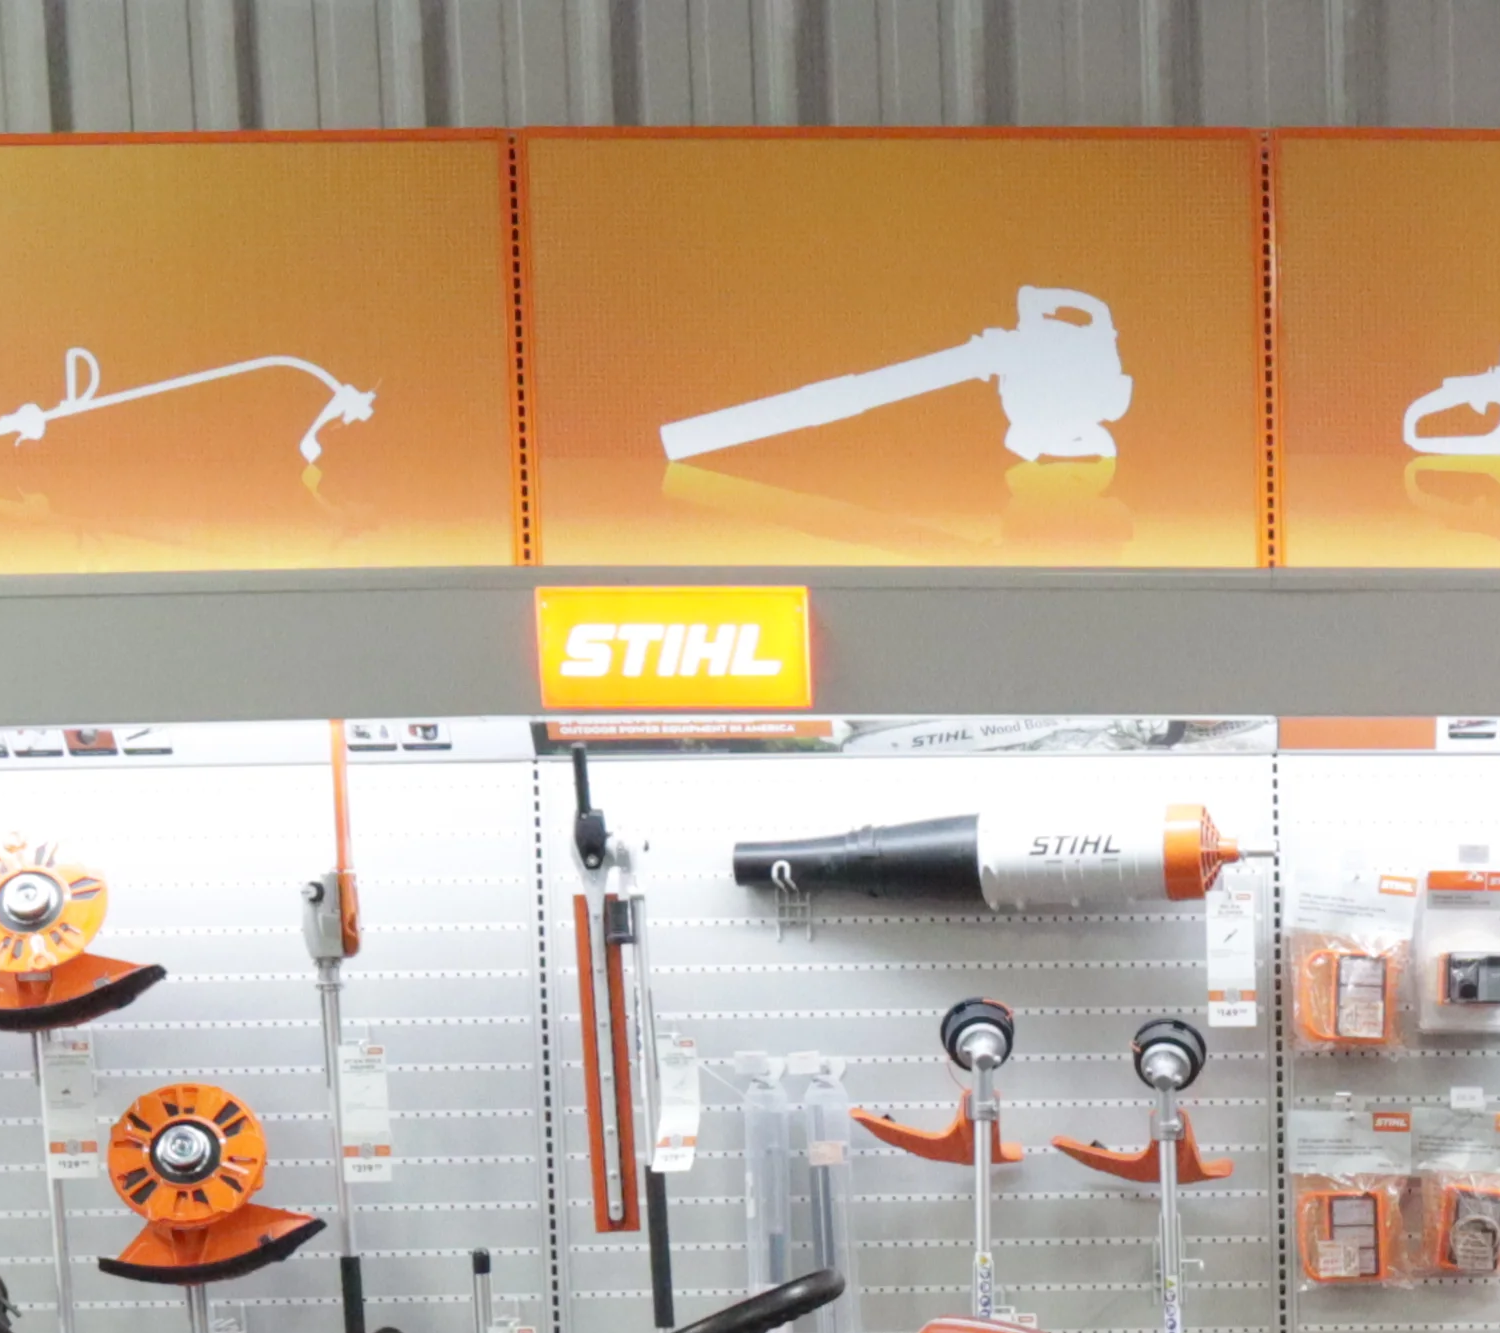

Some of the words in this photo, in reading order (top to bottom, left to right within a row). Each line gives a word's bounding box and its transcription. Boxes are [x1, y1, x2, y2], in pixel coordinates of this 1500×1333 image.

[558, 623, 783, 678] STIHL
[559, 725, 618, 735] OUTDOOR
[619, 725, 660, 734] POWER
[662, 724, 728, 734] EQUIPMENT
[744, 723, 795, 733] AMERICA
[911, 729, 974, 748] STIHL
[980, 721, 1021, 737] Wood
[1028, 833, 1122, 857] STIHL
[1374, 1117, 1408, 1128] STIHL
